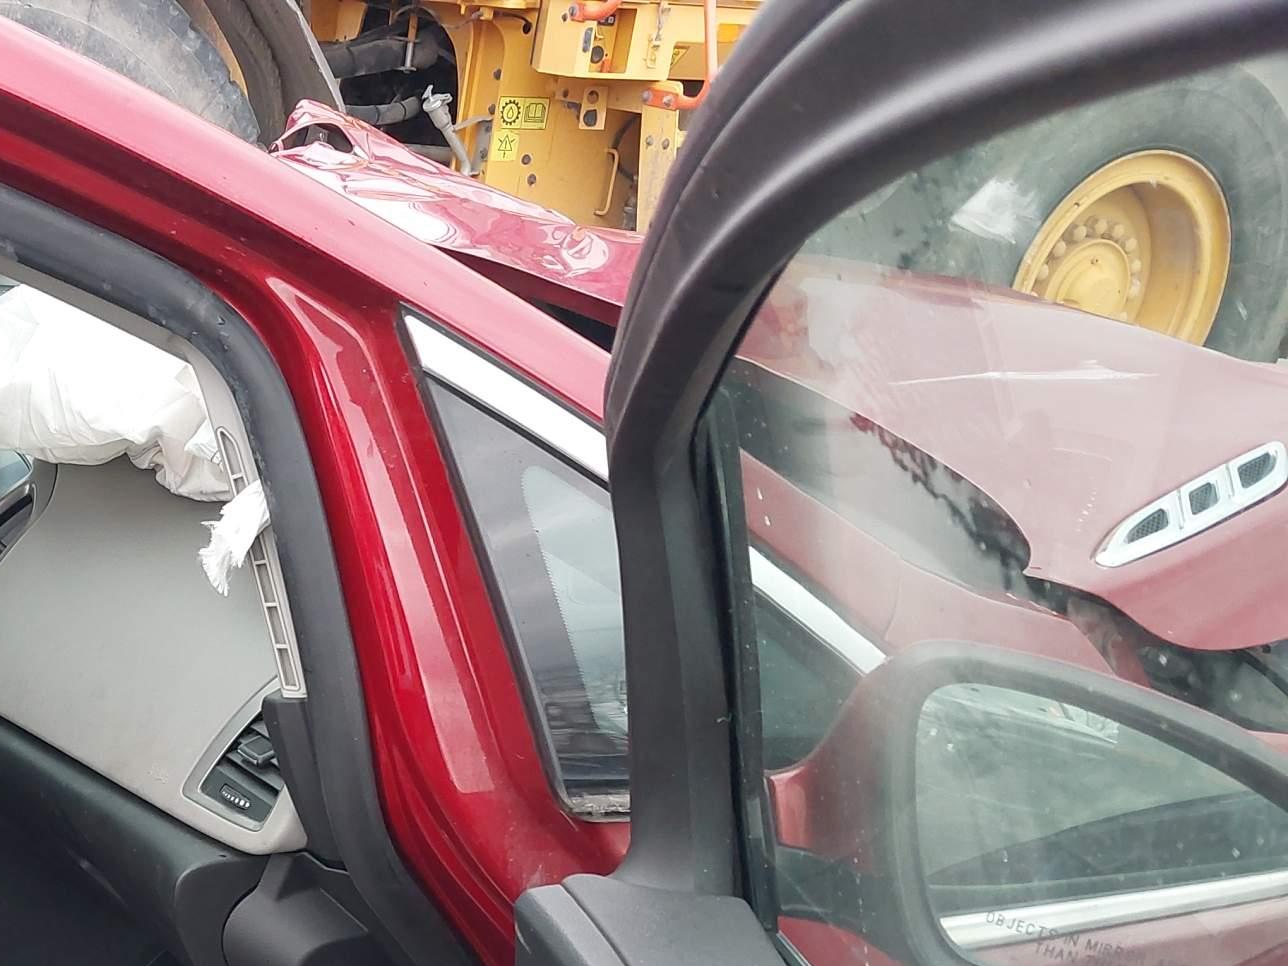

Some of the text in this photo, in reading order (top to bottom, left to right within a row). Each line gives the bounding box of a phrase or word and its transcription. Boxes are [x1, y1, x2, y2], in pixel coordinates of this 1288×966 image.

[986, 911, 1059, 940] OBJECTS
[1063, 934, 1081, 948] IN
[1034, 941, 1081, 965] THAN
